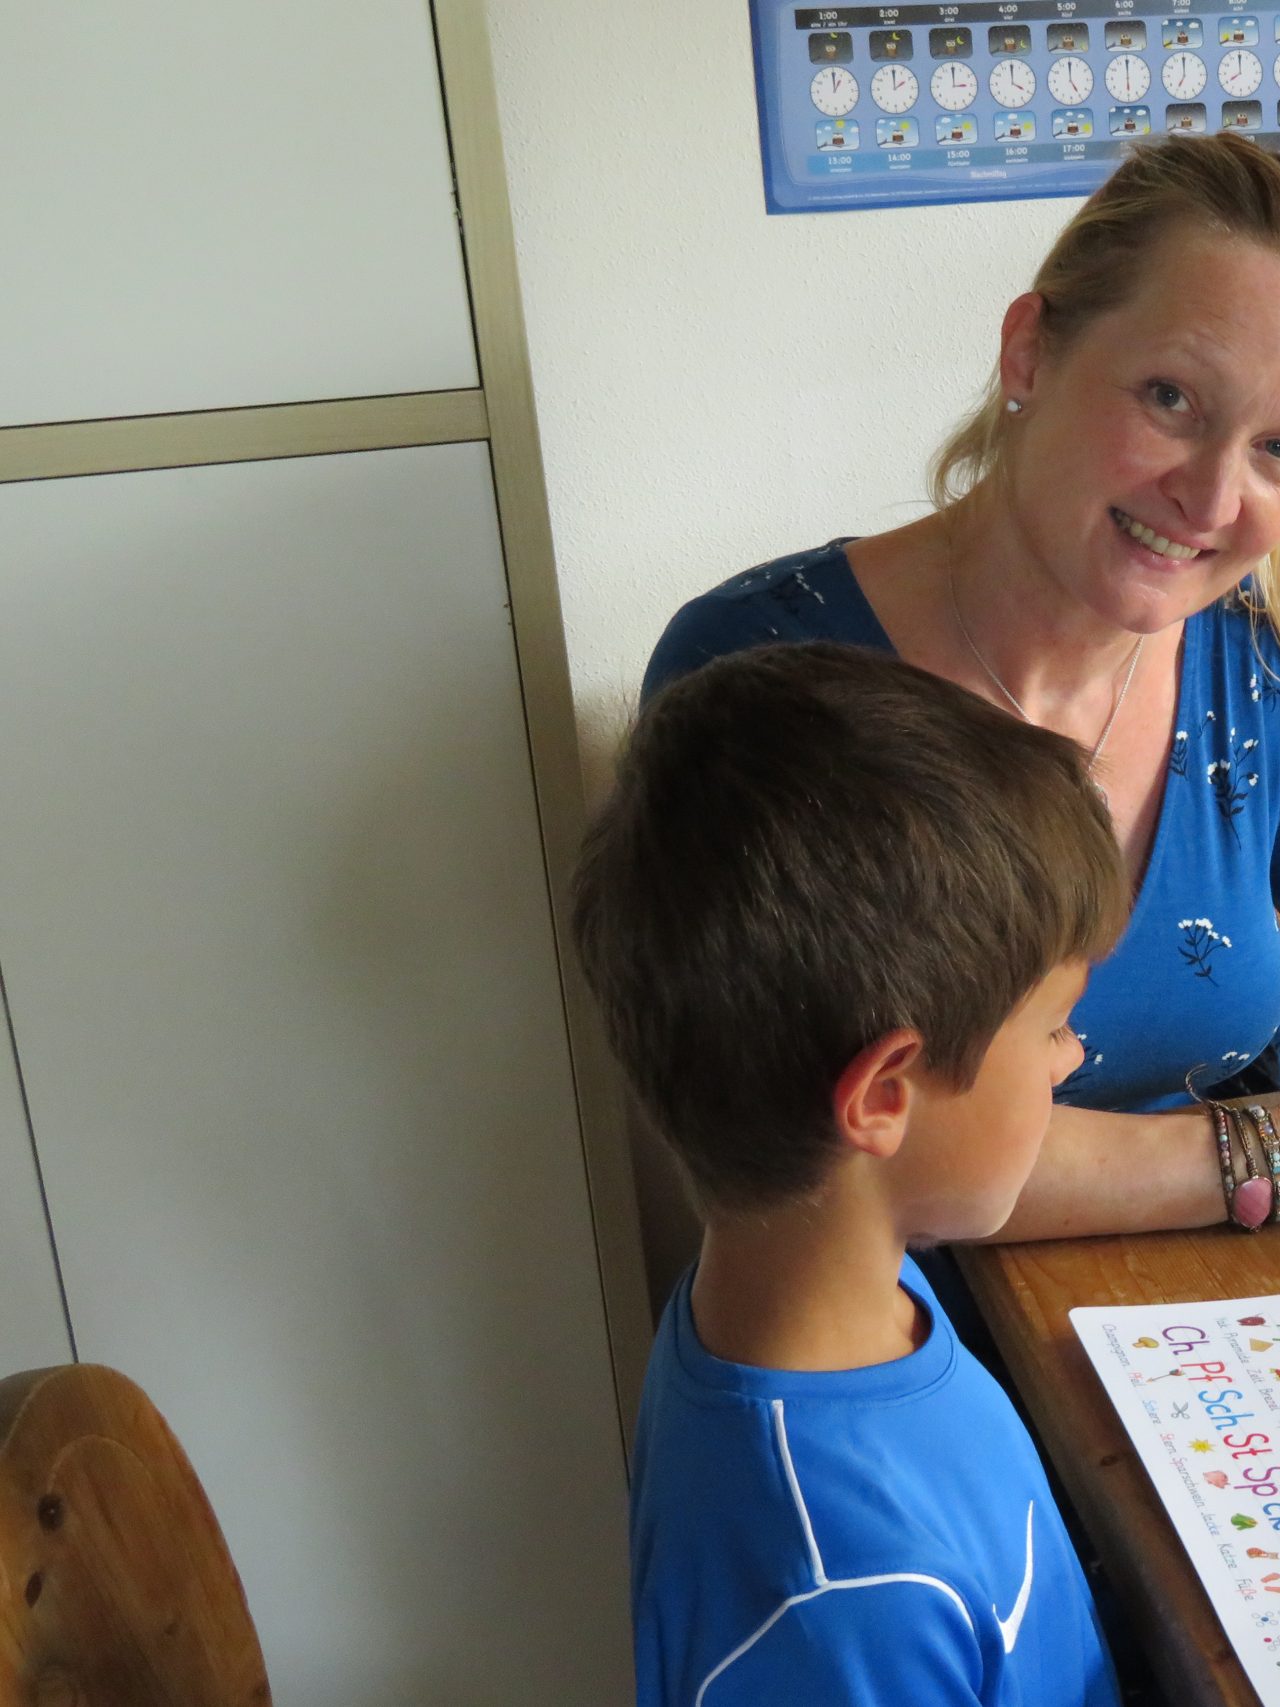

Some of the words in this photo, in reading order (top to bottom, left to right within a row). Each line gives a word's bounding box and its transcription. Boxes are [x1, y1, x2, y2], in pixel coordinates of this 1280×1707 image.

[819, 11, 838, 20] 1:00
[879, 9, 899, 18] 2:00
[939, 7, 959, 16] 3:00
[998, 4, 1018, 13] 4:00
[1057, 2, 1076, 11] 5:00
[1115, 0, 1134, 9] 6:00
[1063, 144, 1085, 153] 17:00
[1162, 1326, 1210, 1356] Ch
[1180, 1361, 1233, 1383] Pf
[1198, 1389, 1255, 1431] Sch
[1223, 1433, 1273, 1460] St
